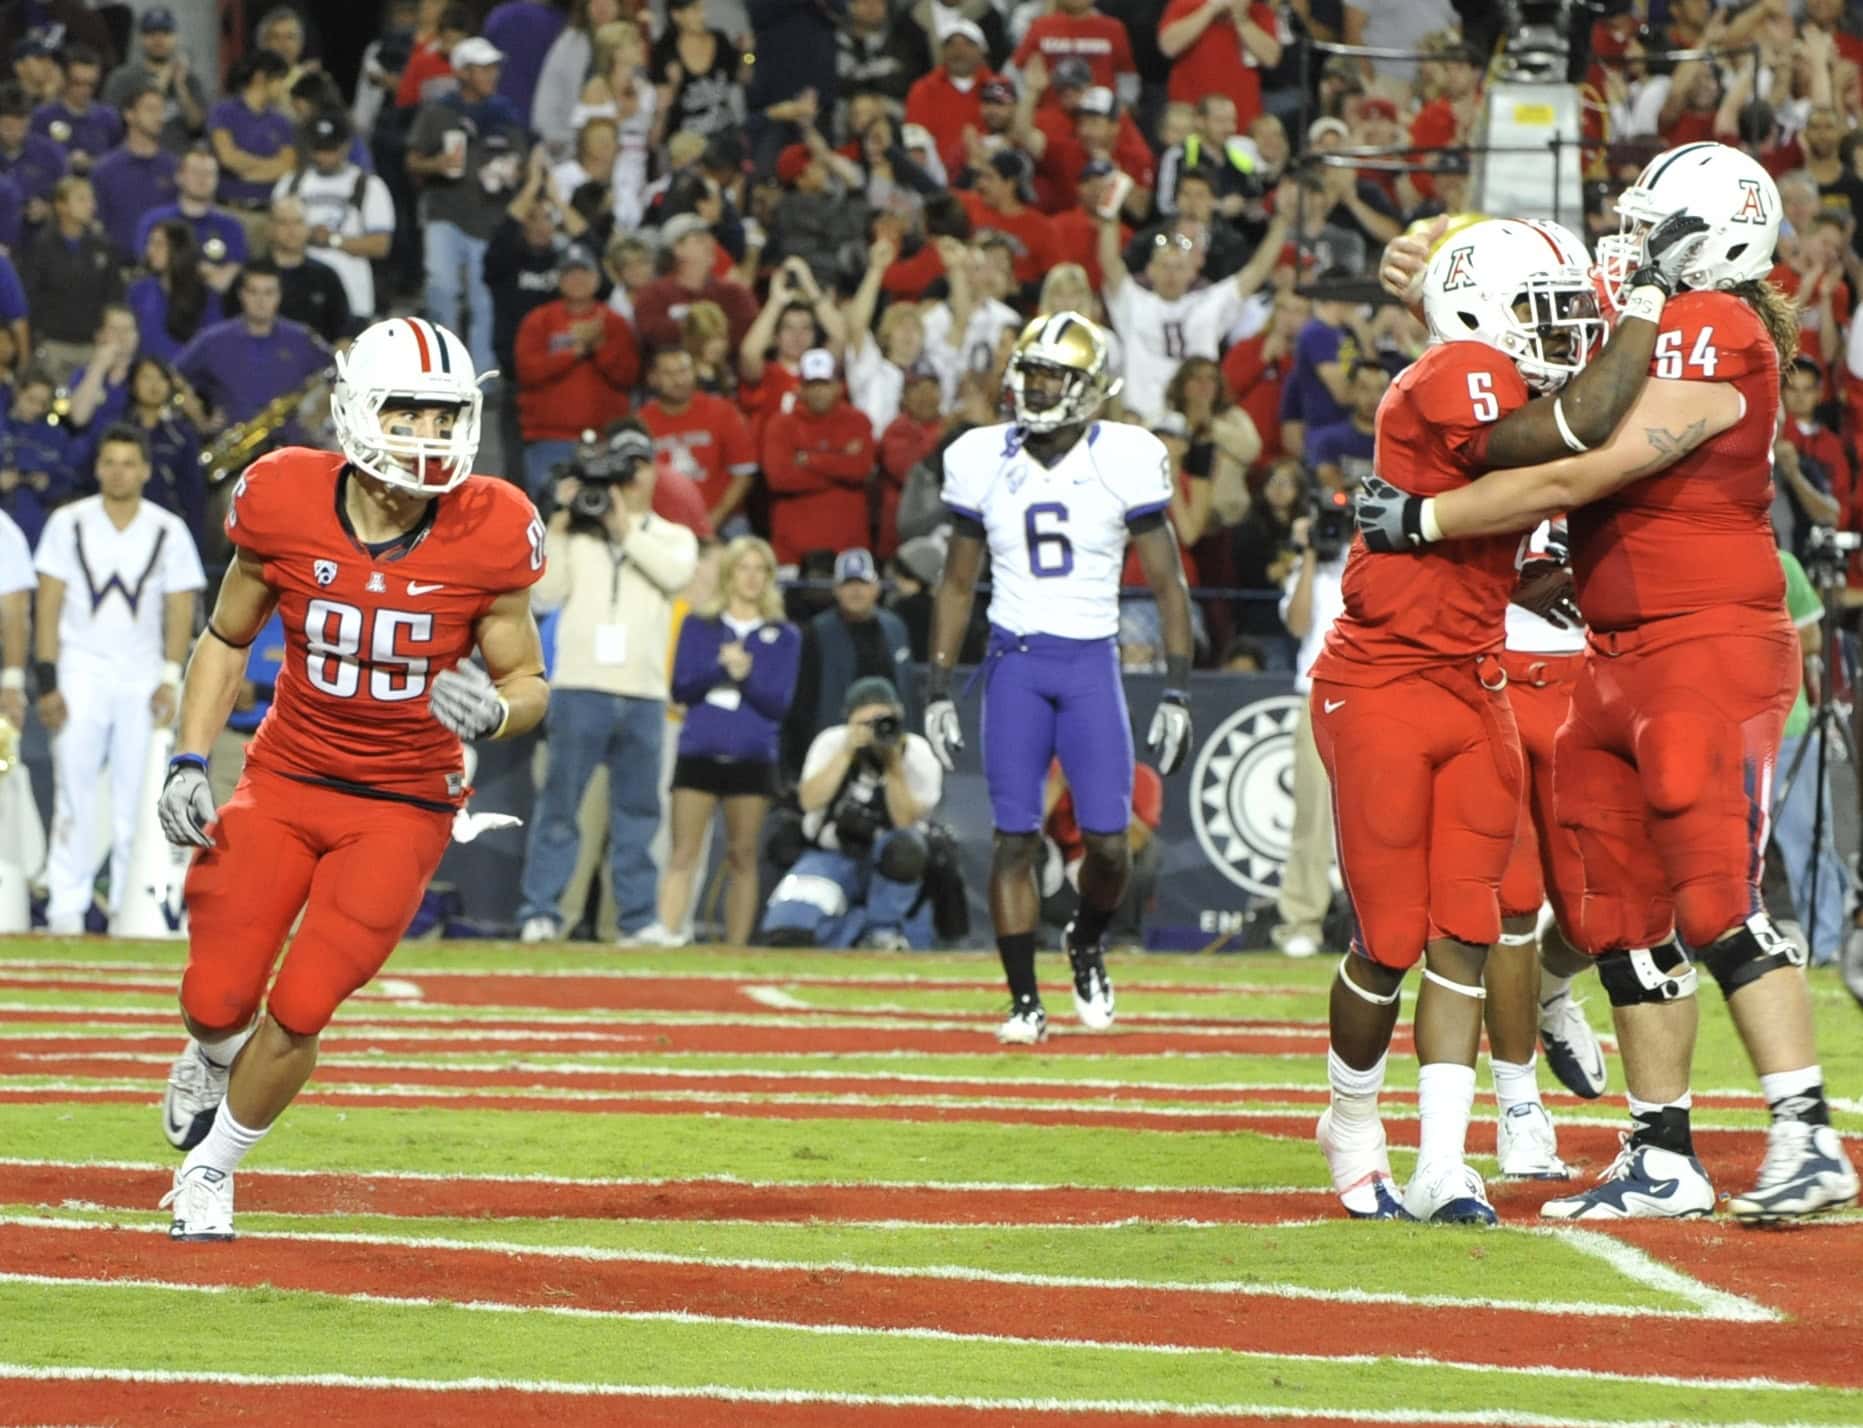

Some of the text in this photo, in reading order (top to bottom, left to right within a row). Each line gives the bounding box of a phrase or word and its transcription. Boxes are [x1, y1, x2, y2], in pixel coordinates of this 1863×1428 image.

[1730, 178, 1768, 226] A
[1442, 244, 1477, 292] A
[1466, 370, 1499, 422] 5
[72, 519, 167, 618] W
[1024, 501, 1074, 578] 6
[304, 597, 435, 702] 85
